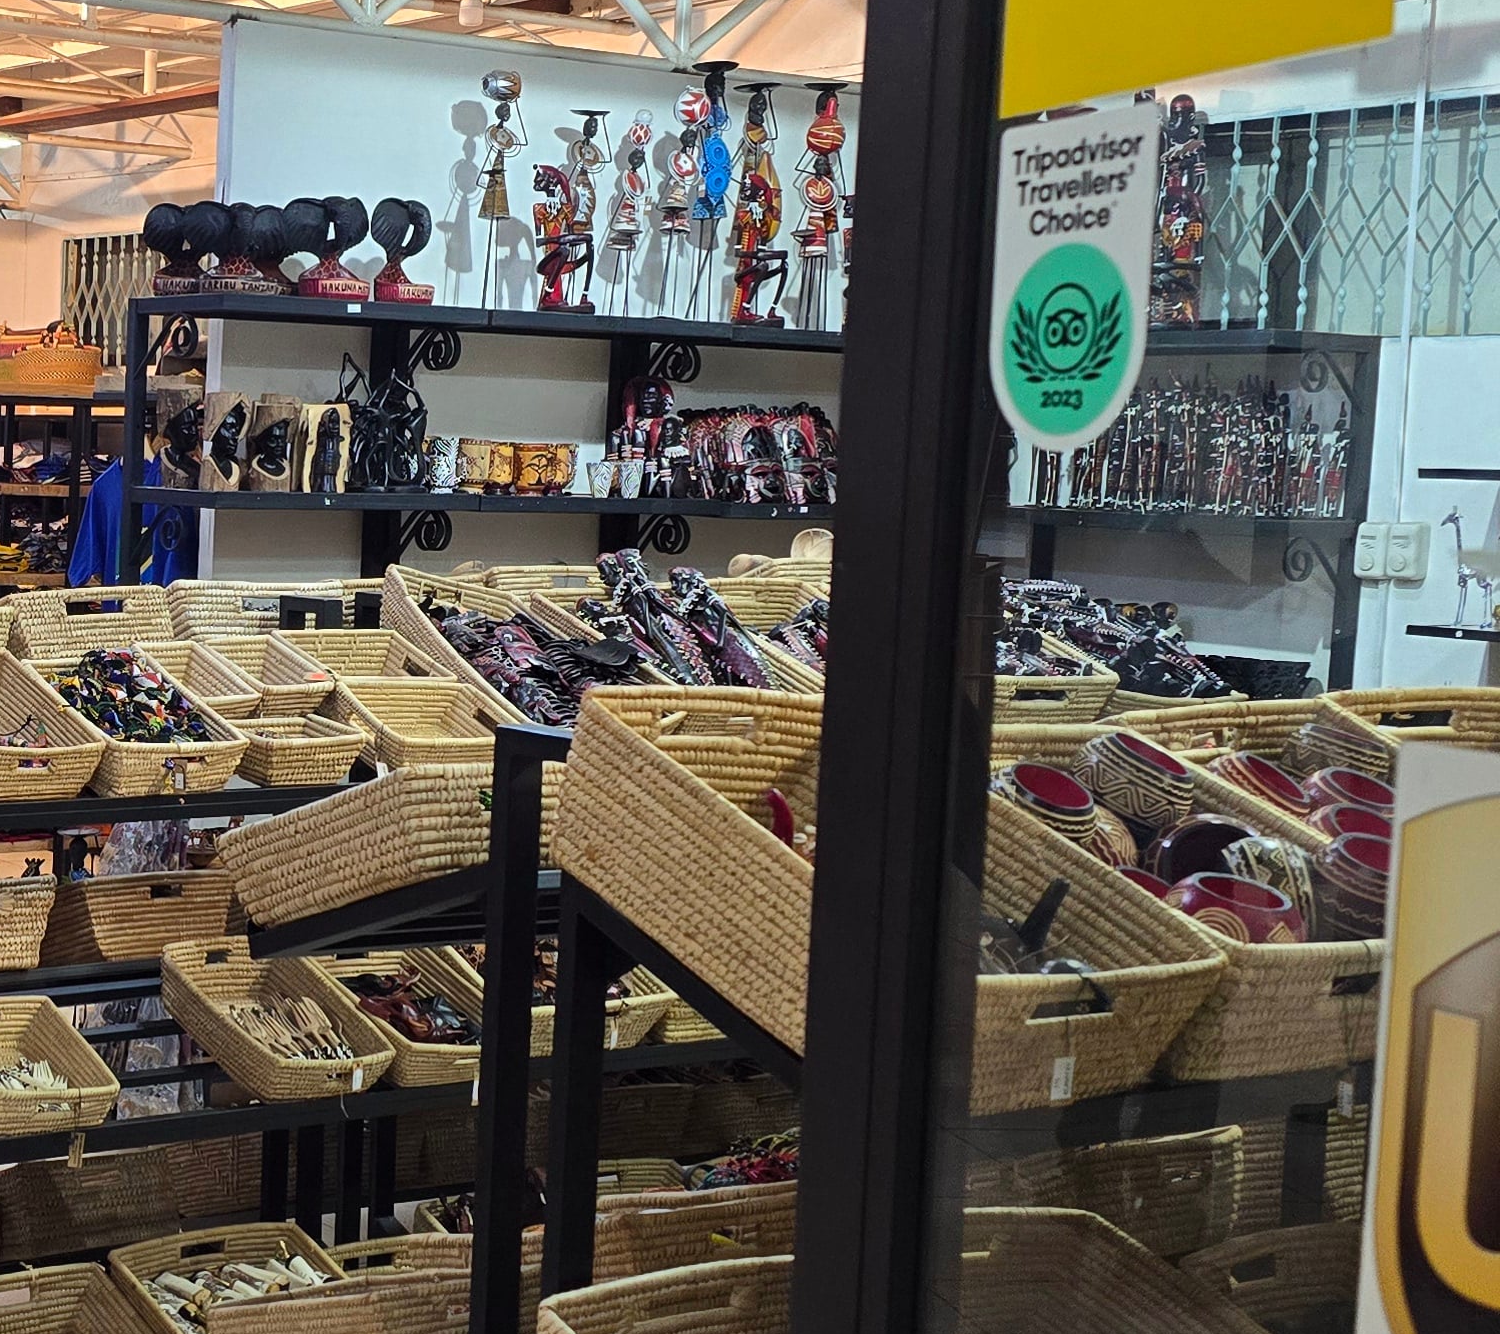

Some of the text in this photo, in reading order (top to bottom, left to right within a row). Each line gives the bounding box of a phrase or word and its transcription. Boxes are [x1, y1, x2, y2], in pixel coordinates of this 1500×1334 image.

[1013, 133, 1144, 178] Tripadvisor
[1029, 202, 1112, 236] Choice
[1040, 389, 1083, 411] 2023
